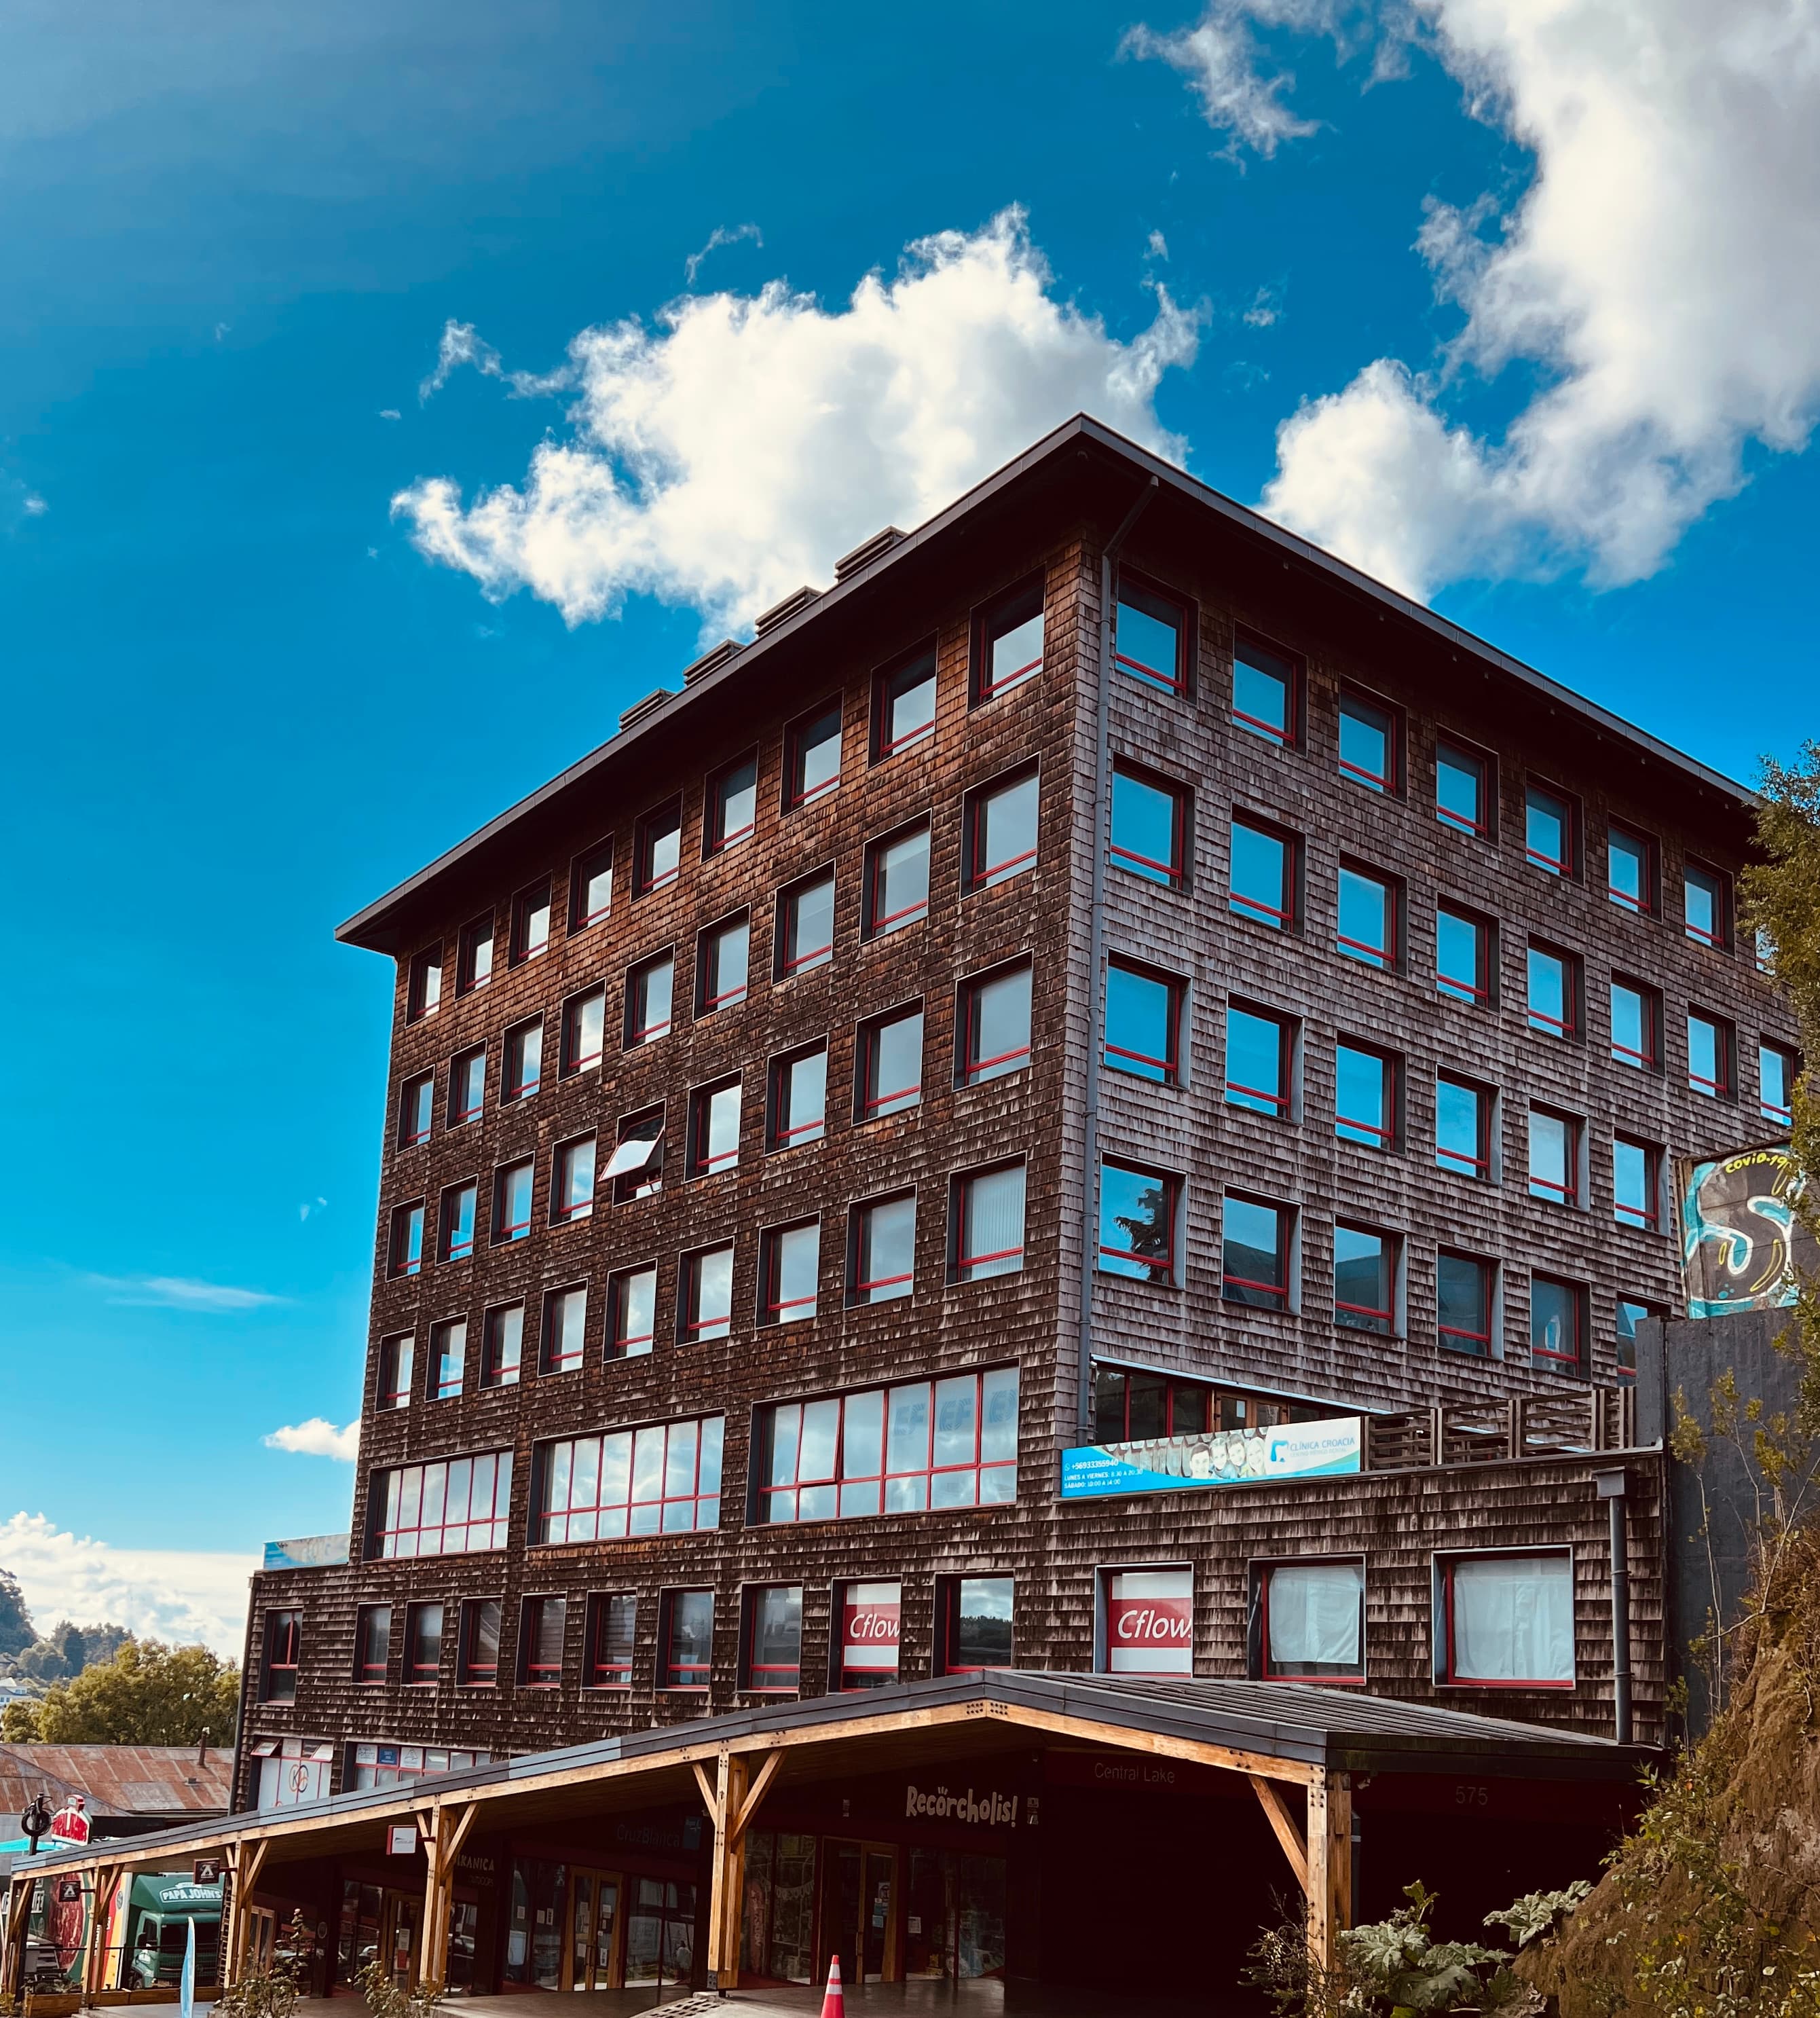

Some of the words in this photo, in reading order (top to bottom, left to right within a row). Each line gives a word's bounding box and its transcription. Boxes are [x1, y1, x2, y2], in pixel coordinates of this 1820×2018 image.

[1290, 1441, 1319, 1451] CLÍNICA
[1322, 1437, 1355, 1448] CROACIA
[1094, 1762, 1139, 1780] Central
[1144, 1765, 1175, 1784] Lake
[1455, 1786, 1489, 1805] 575
[616, 1824, 680, 1847] CruzBlanca
[456, 1854, 495, 1871] LKANICA
[162, 1889, 189, 1900] PAPA
